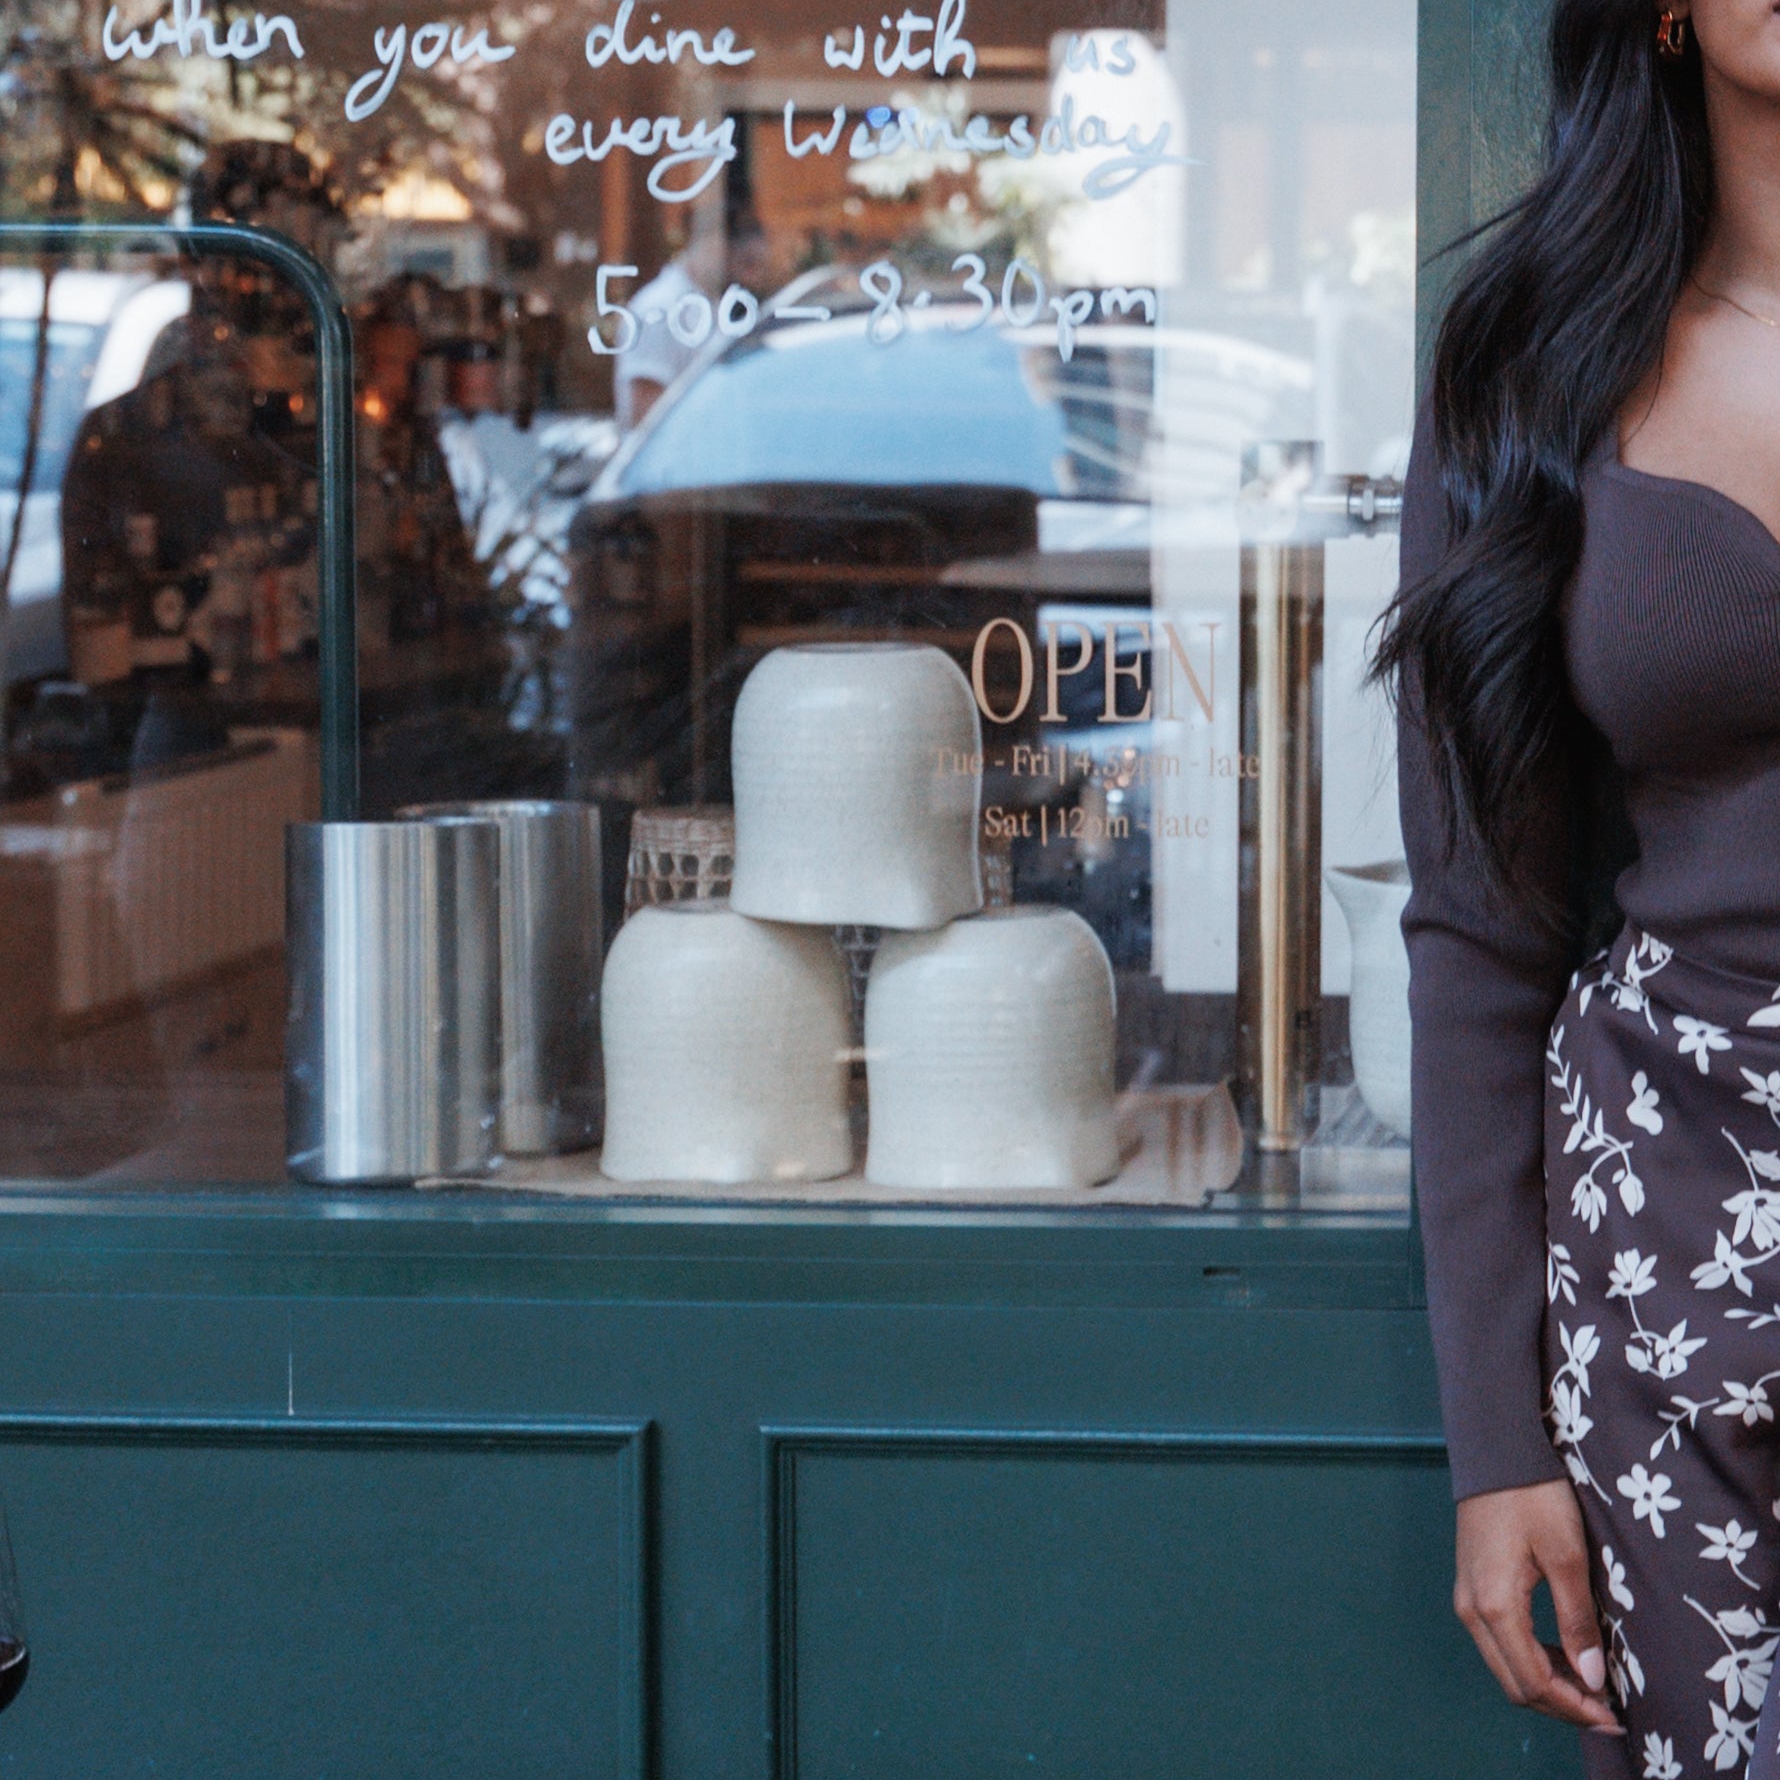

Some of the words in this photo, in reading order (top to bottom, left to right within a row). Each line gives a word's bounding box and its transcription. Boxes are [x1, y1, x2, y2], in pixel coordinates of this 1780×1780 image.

[346, 21, 515, 121] you
[1064, 30, 1137, 75] us
[544, 112, 737, 202] every
[784, 93, 1208, 200] Wednesday
[972, 617, 1222, 724] OPEN
[933, 747, 983, 776] Tue
[1012, 746, 1050, 776] Fri
[1208, 747, 1261, 778] late
[984, 805, 1032, 839] Sat
[1057, 807, 1130, 844] 12pm
[1156, 807, 1210, 839] late
